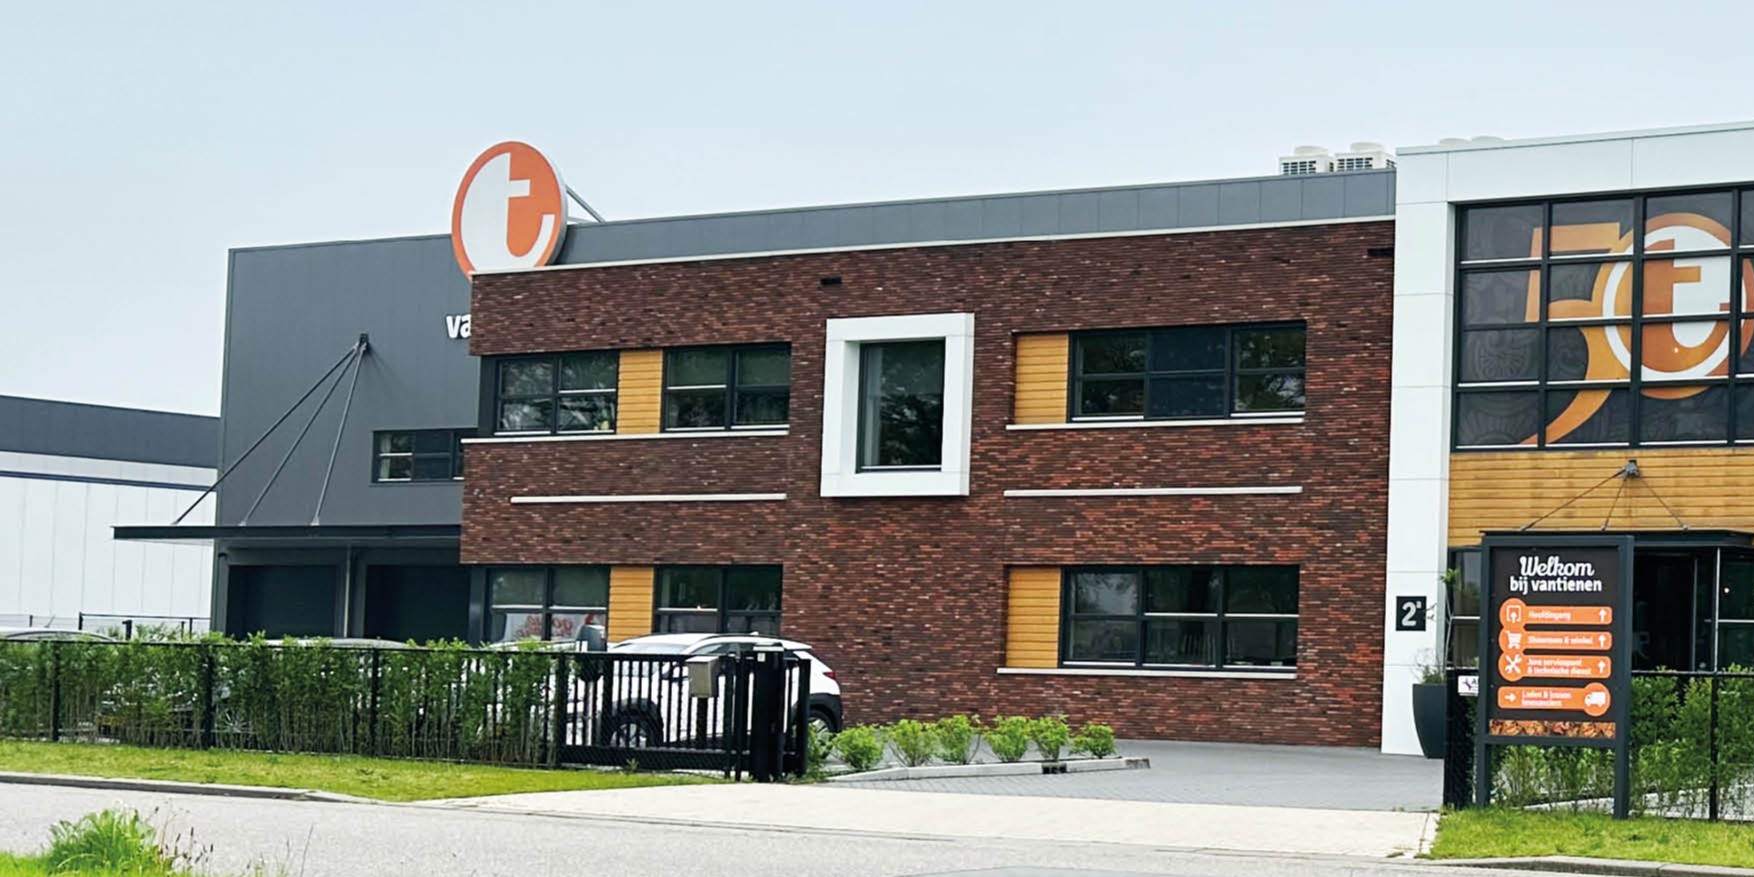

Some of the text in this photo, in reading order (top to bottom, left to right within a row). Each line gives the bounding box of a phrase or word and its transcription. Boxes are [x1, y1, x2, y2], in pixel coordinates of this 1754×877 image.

[1519, 556, 1595, 576] Welkom
[1510, 576, 1602, 595] bij vantienen
